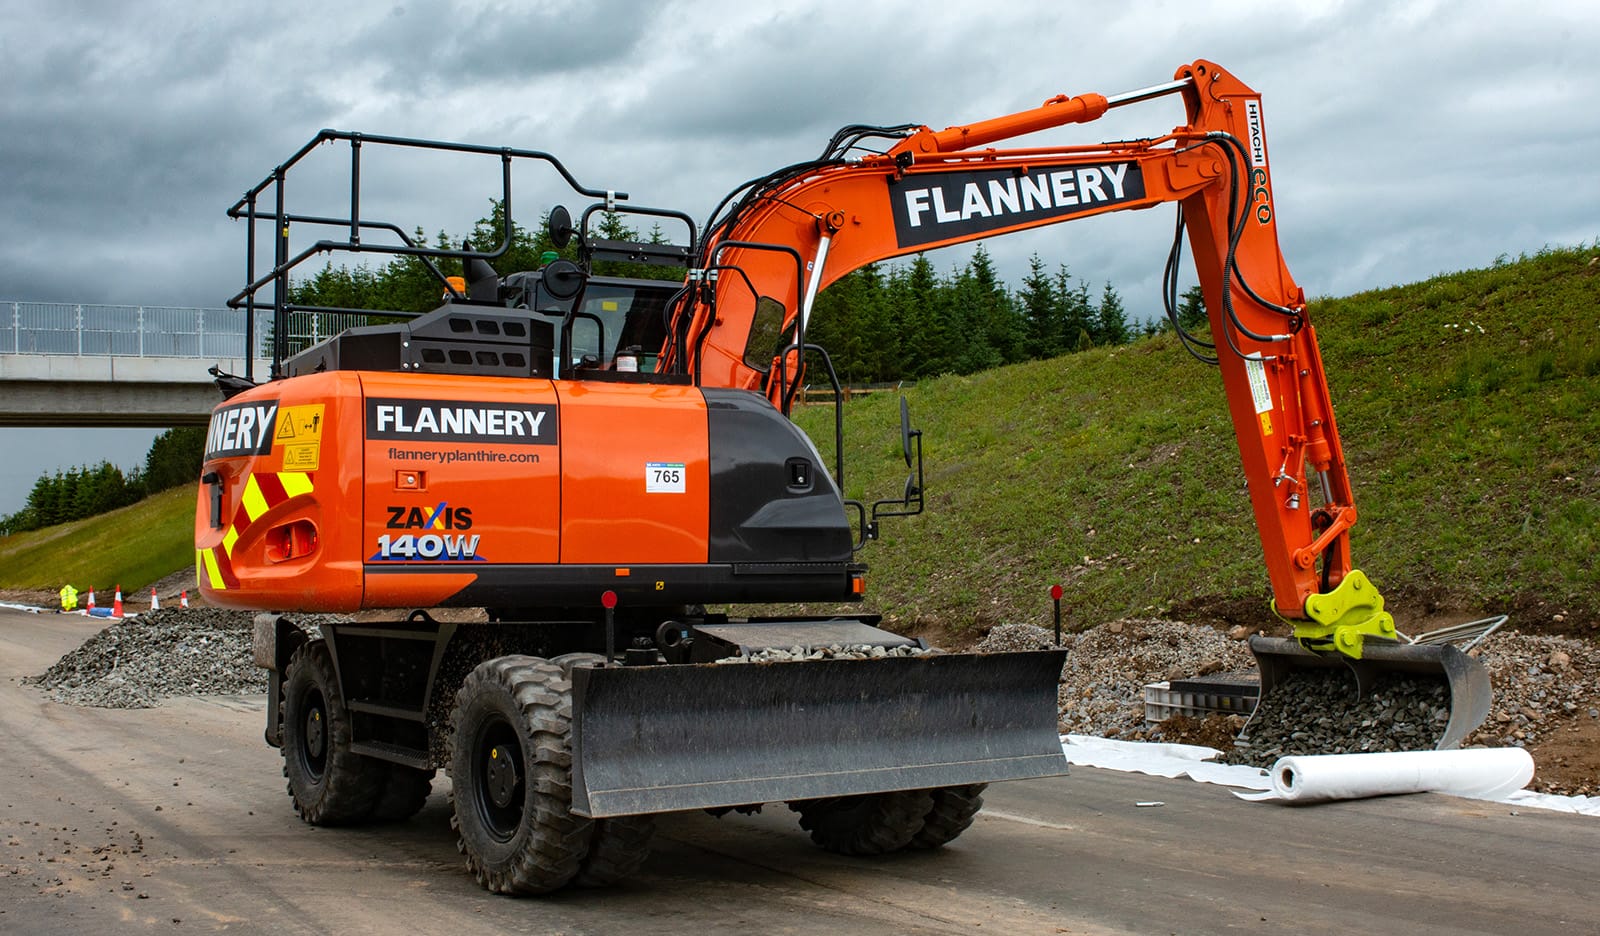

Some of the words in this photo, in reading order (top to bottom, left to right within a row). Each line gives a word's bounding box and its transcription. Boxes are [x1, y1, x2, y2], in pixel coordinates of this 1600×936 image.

[1249, 104, 1262, 162] HITACHI
[905, 163, 1128, 227] FLANNERY
[1253, 168, 1272, 224] eco
[376, 405, 546, 436] FLANNERY
[388, 447, 540, 463] flanneryplanthire.com
[654, 470, 680, 483] 765
[386, 501, 473, 530] ZAXIS
[378, 534, 480, 560] 140W
